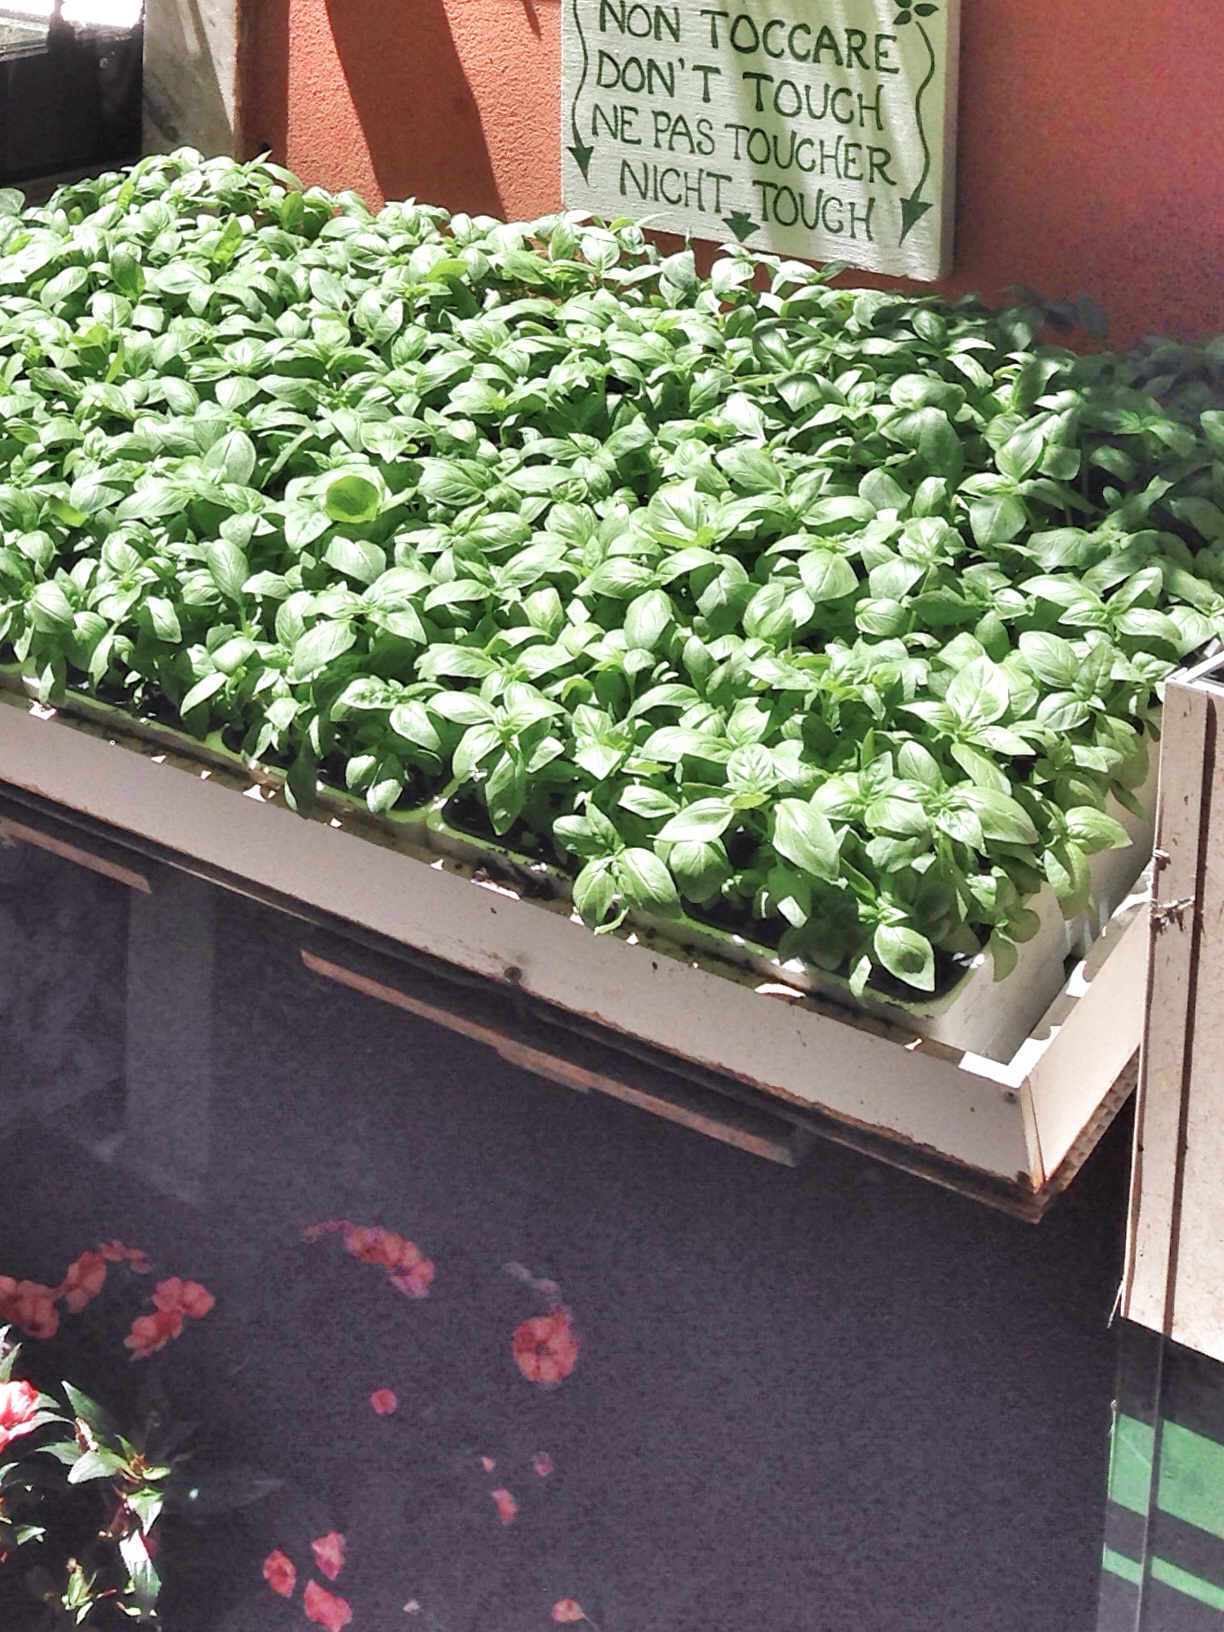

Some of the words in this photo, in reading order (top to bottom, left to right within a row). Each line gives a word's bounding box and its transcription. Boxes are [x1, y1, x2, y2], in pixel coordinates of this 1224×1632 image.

[700, 9, 901, 75] TOCCARE
[596, 49, 721, 103] DON'T
[742, 71, 885, 132] TOUCH
[591, 103, 642, 145] NE
[652, 110, 715, 156] PAS
[725, 123, 898, 186] TOUCHER
[619, 159, 733, 214] NICHT
[752, 180, 876, 242] TOUCH
